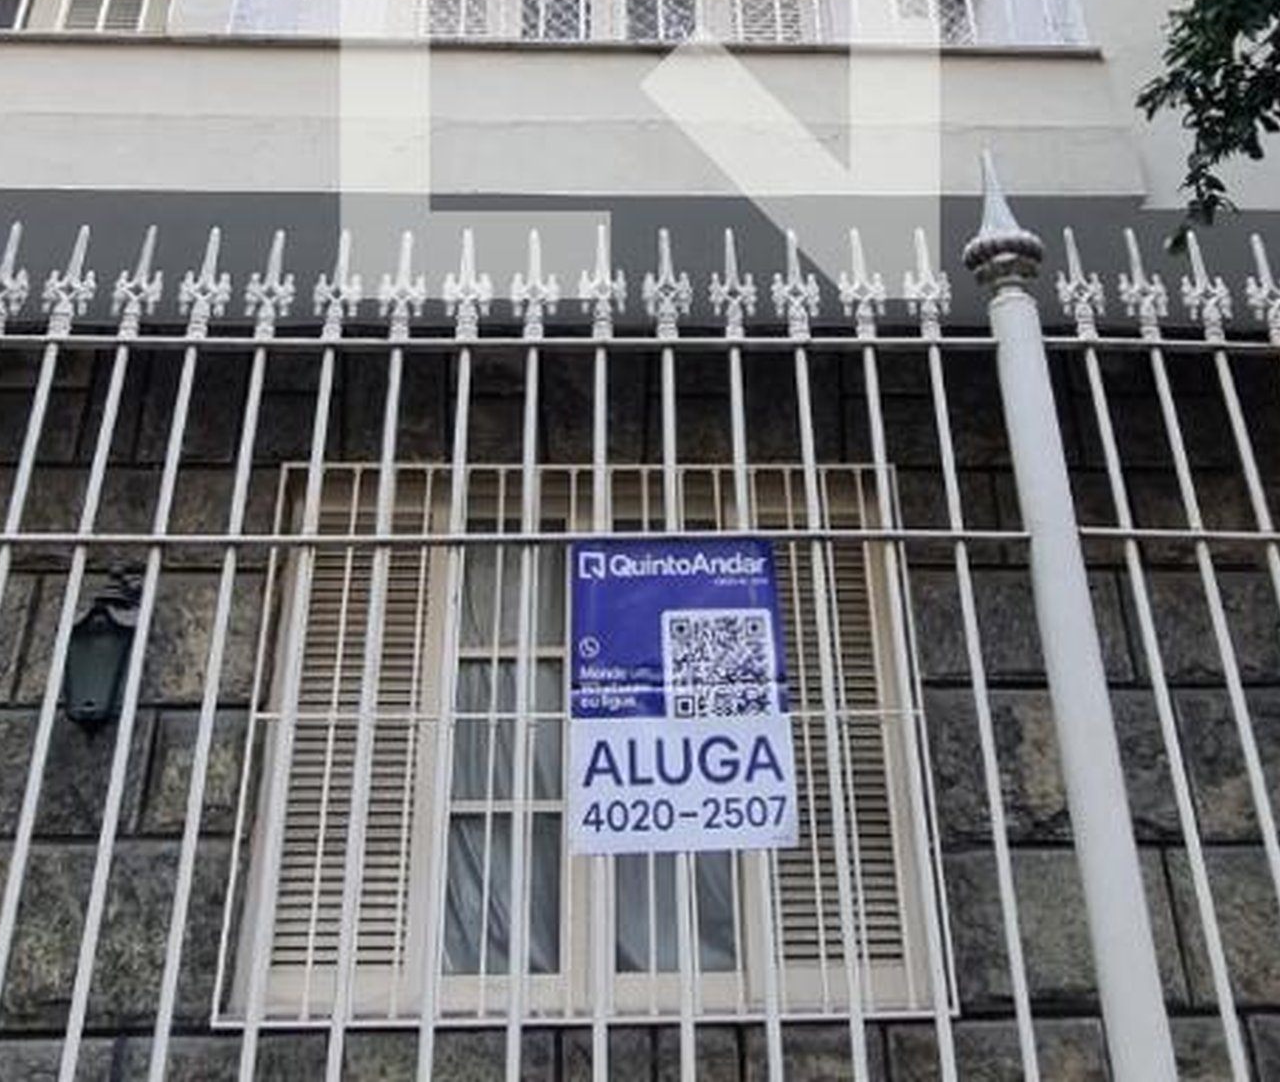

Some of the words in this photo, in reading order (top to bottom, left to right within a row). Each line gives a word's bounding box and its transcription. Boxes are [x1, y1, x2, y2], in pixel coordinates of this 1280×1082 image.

[609, 552, 767, 577] QuintoAndar
[582, 735, 785, 787] ALUGA
[581, 796, 788, 832] 4020-2507
